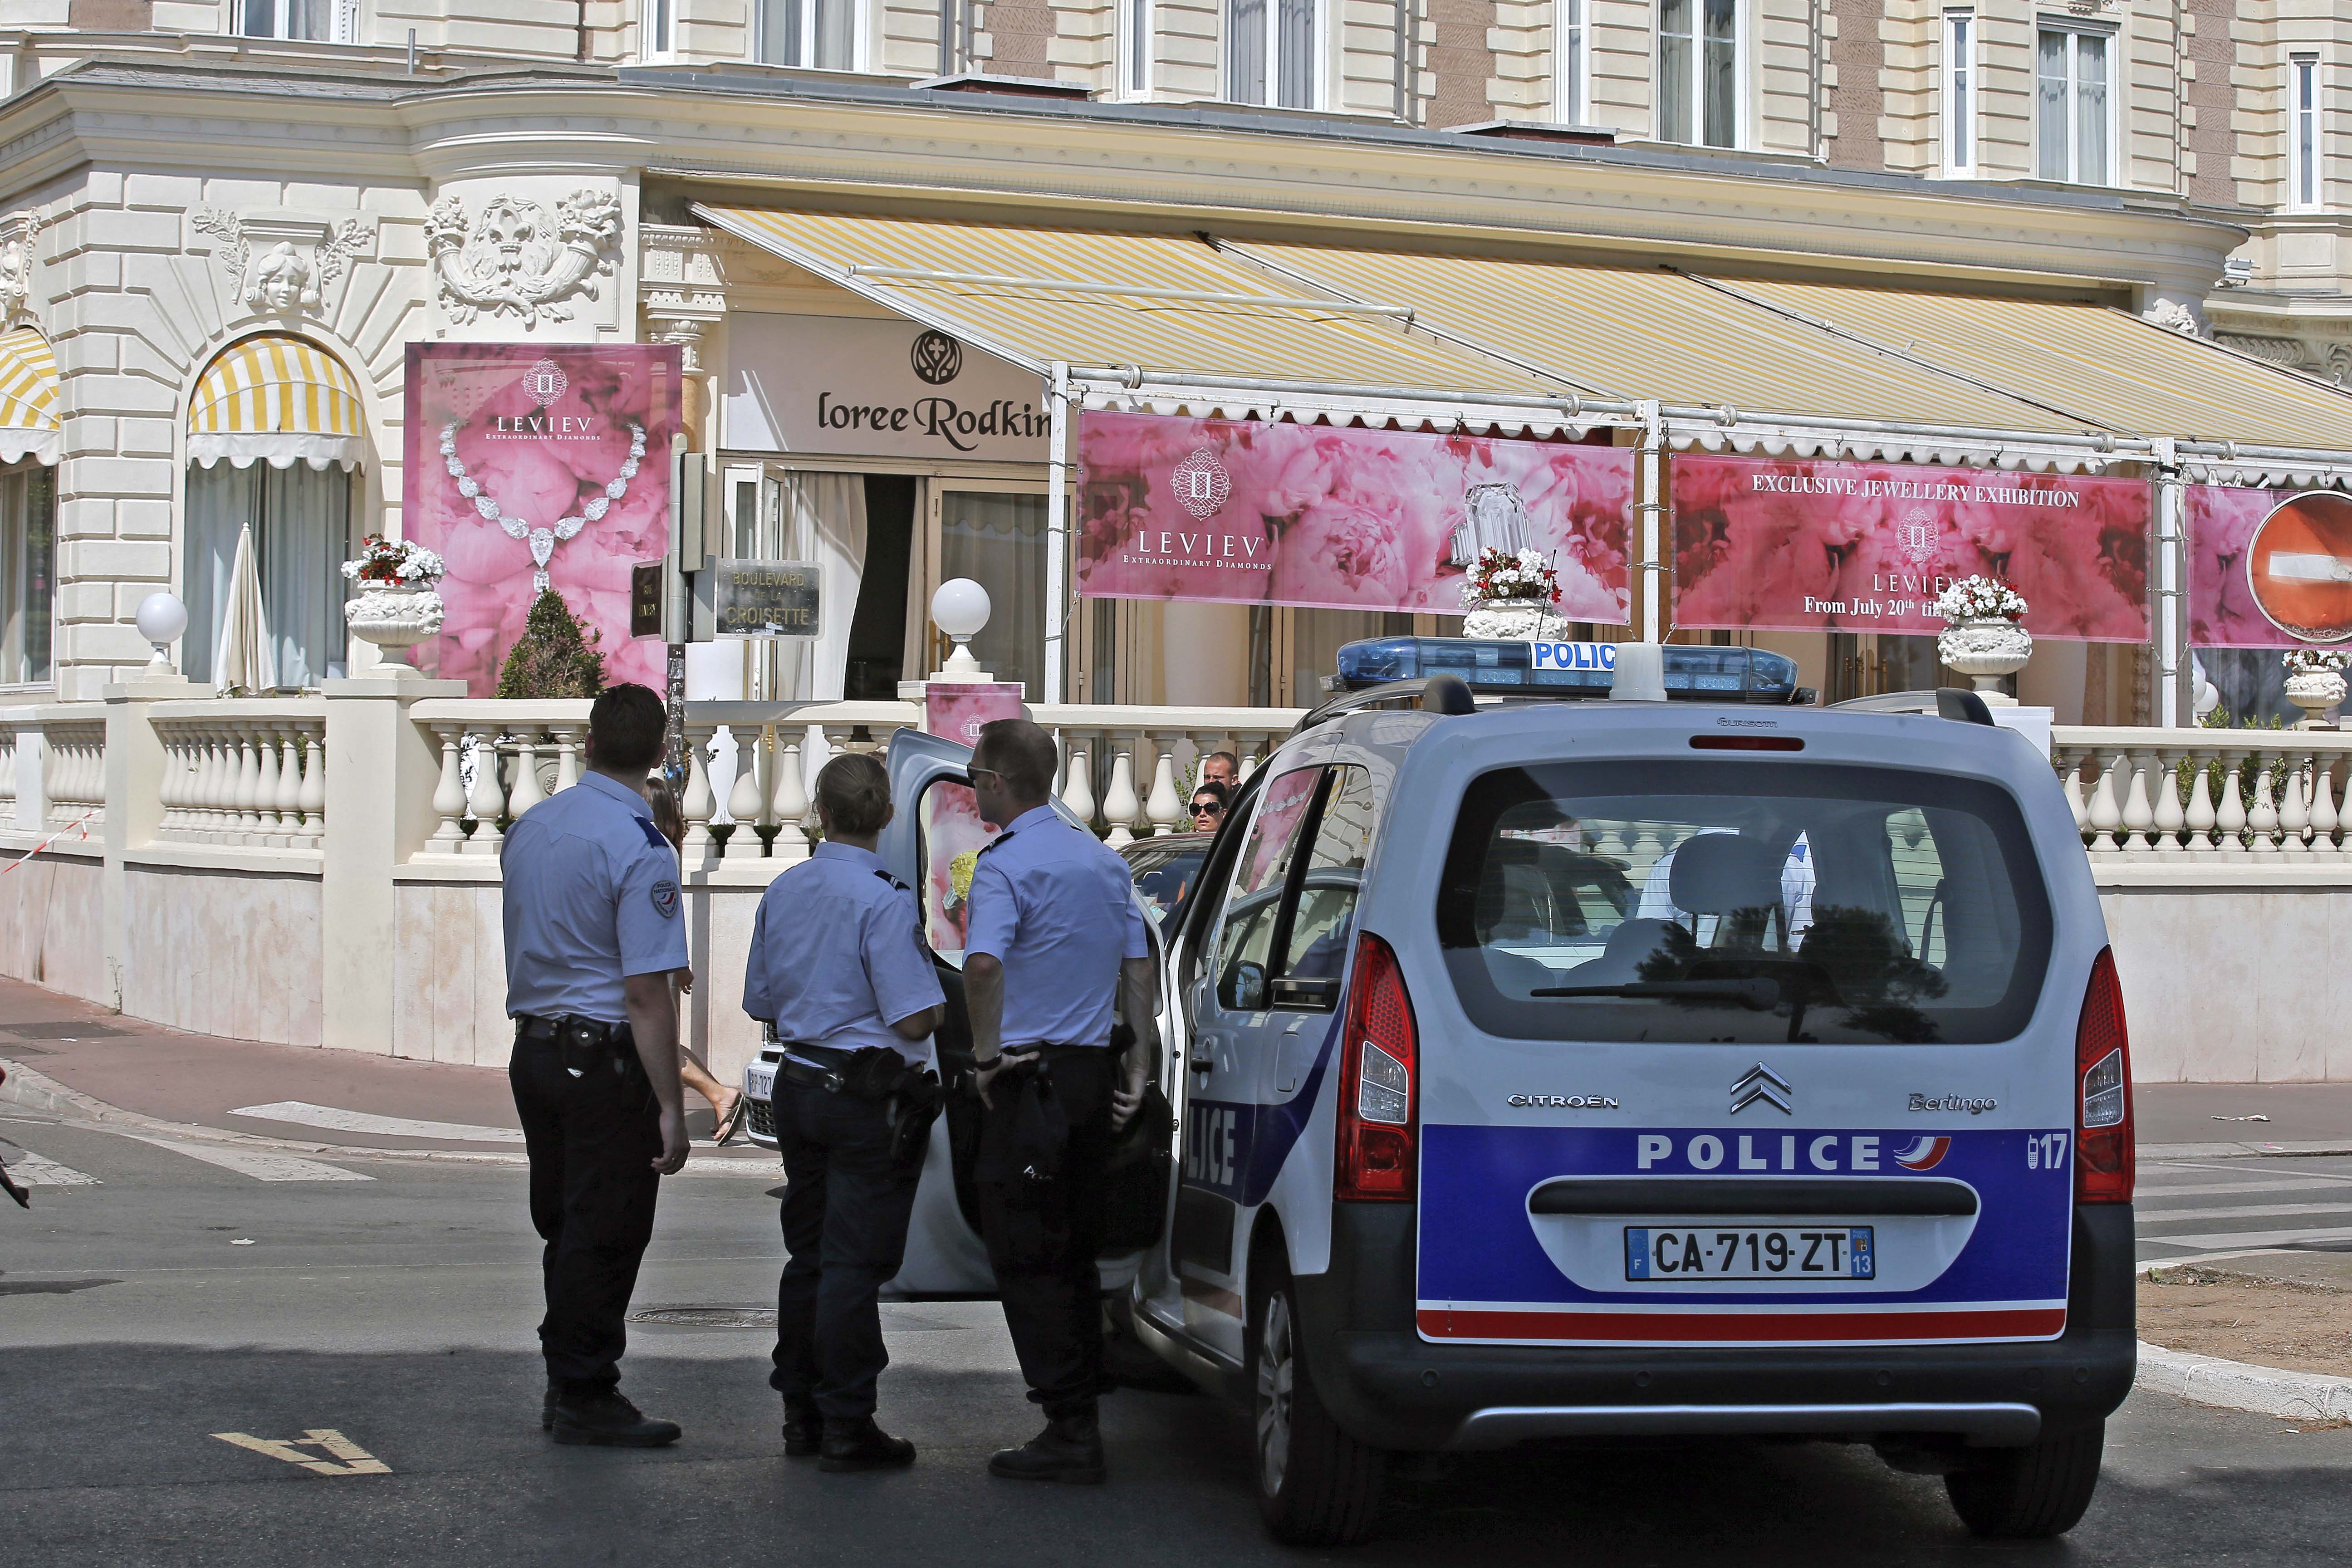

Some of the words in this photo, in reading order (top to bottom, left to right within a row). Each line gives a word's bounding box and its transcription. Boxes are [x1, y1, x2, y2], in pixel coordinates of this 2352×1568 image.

[497, 417, 591, 432] LEVIEV
[1752, 475, 1857, 495] EXCLUSIVE
[1861, 480, 1971, 502] JEWELLERY
[1975, 487, 2079, 508] EXHIBITION
[1139, 530, 1260, 558] LEVIEV
[733, 572, 805, 587] BOULEVARD
[727, 607, 809, 626] CROISETTE
[1804, 596, 1846, 613] From
[1850, 598, 1882, 618] July
[1887, 599, 1915, 616] 20th
[1534, 643, 1615, 669] POLIC
[1507, 1094, 1619, 1109] CITROËN
[1908, 1093, 1997, 1114] Berlingo
[1638, 1135, 1879, 1170] POLICE
[2039, 1134, 2067, 1169] 17
[1853, 1255, 1871, 1273] 13
